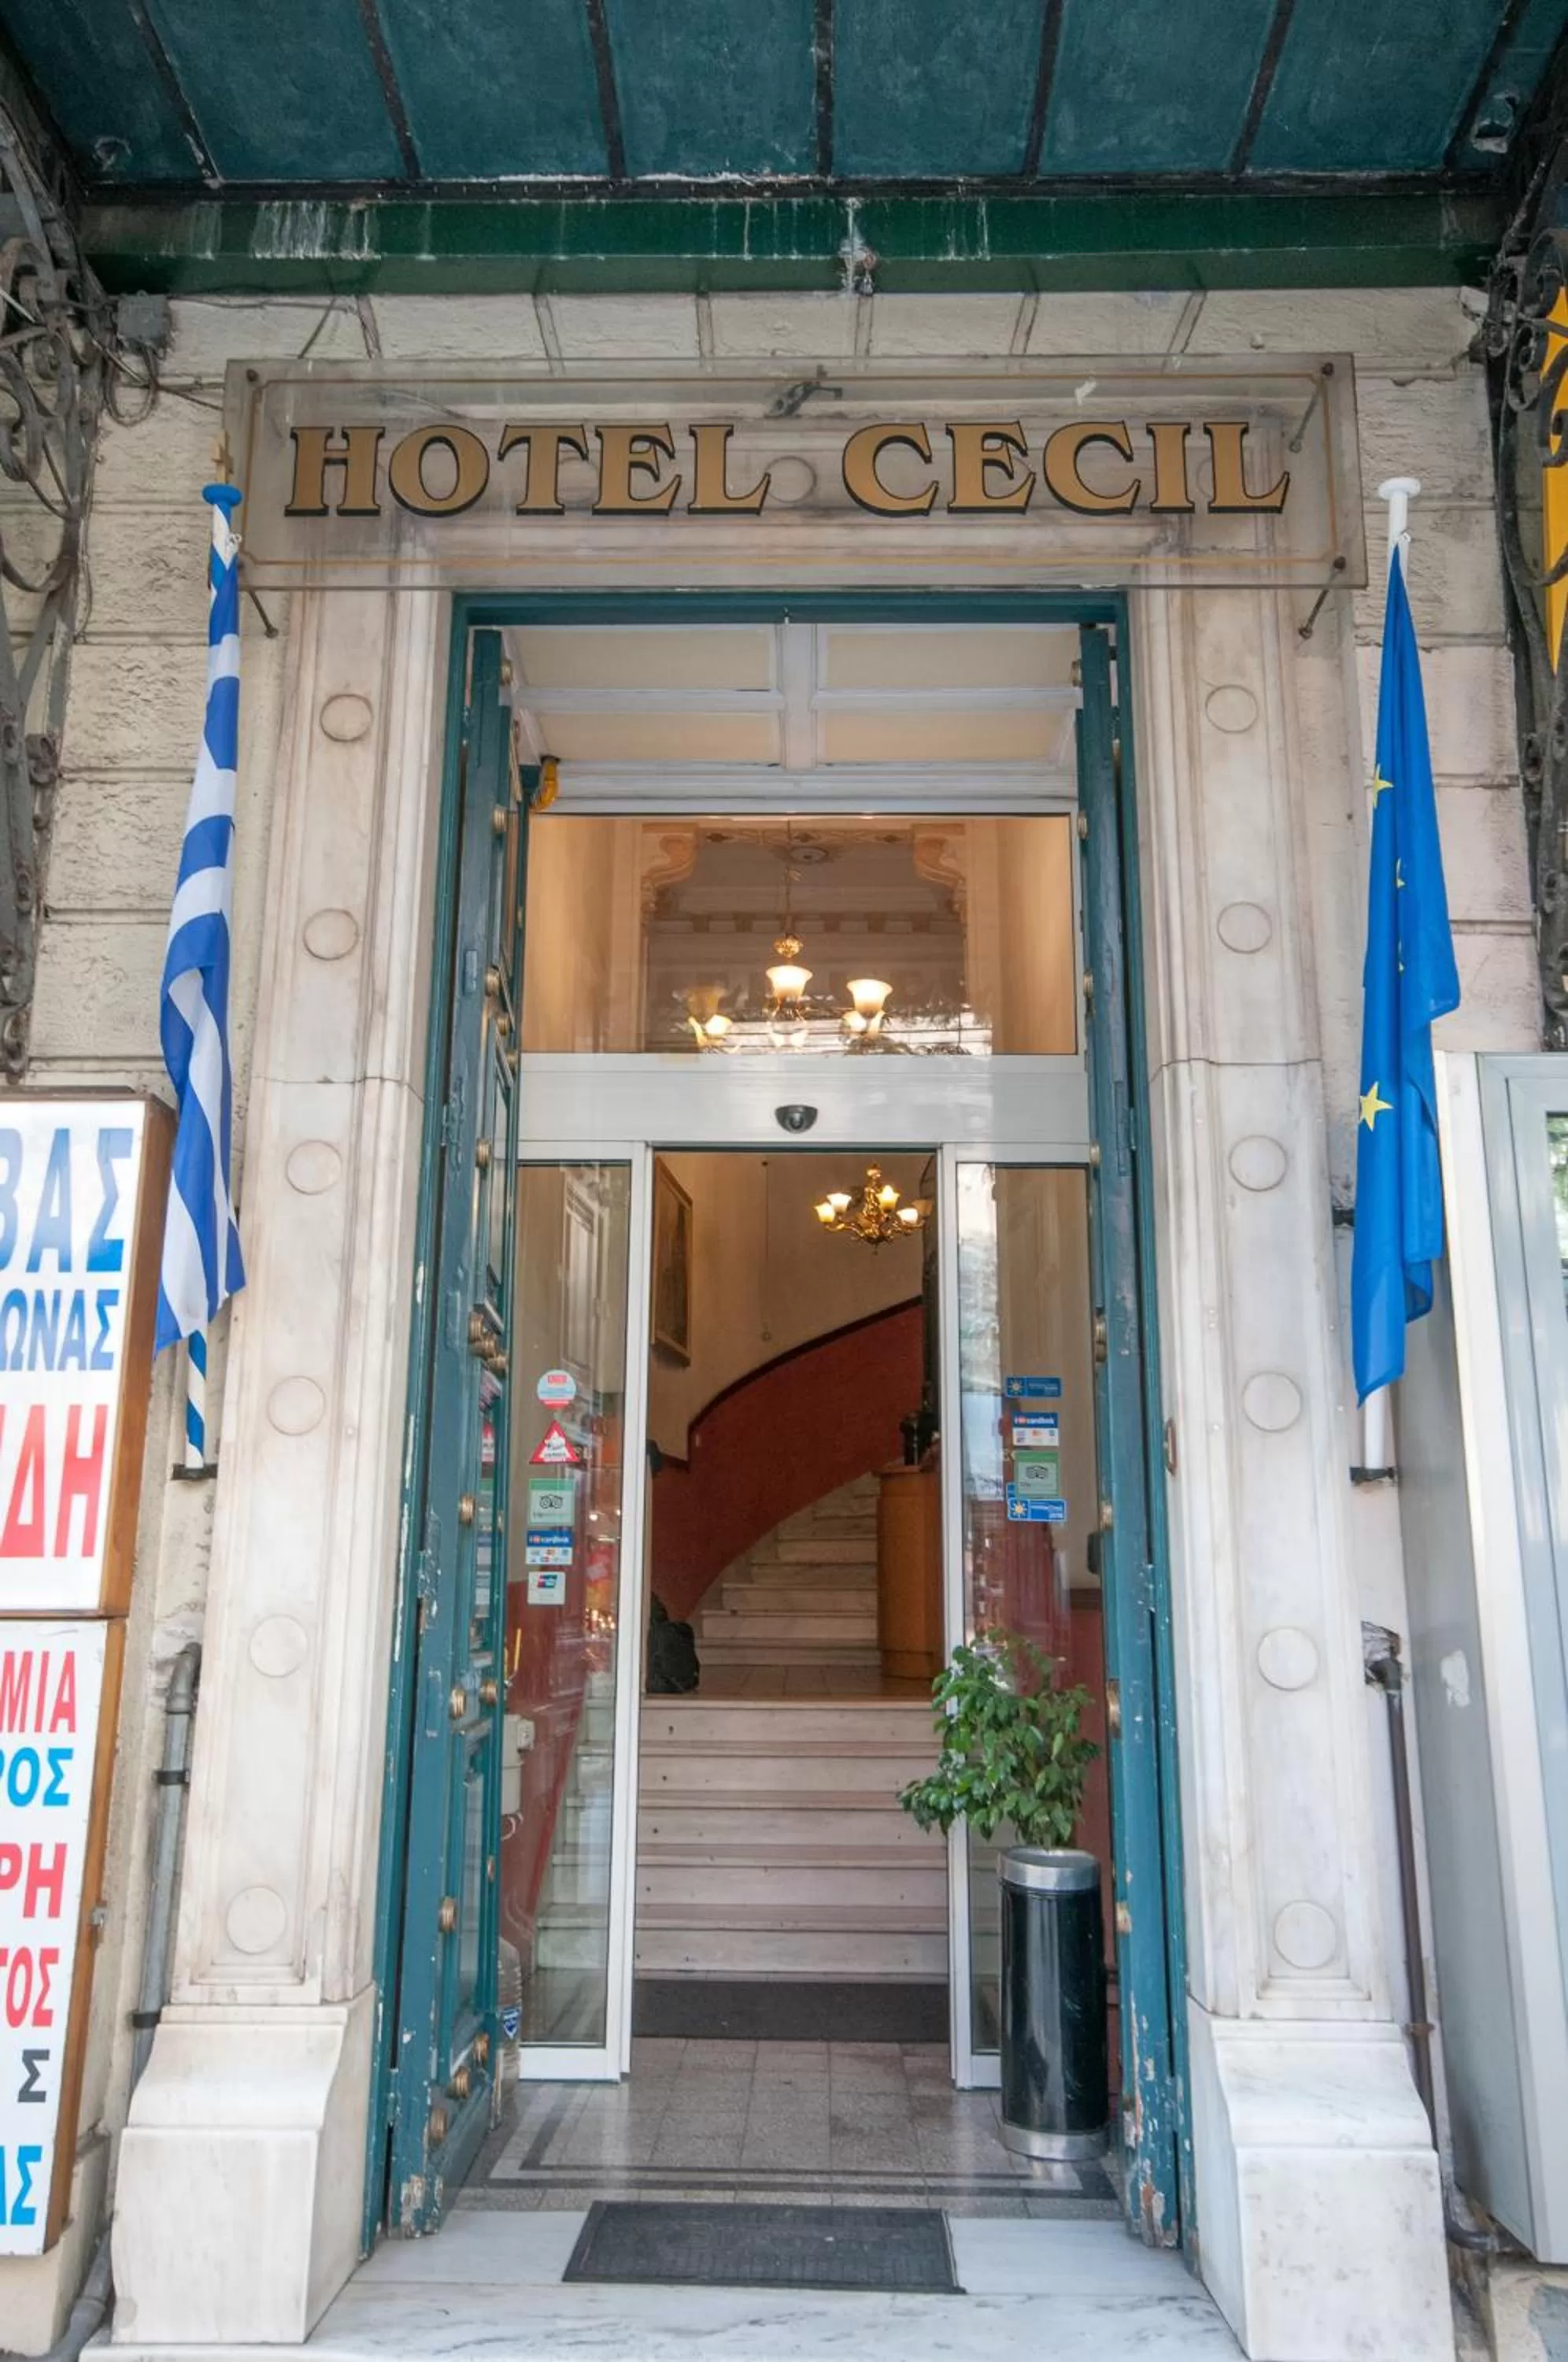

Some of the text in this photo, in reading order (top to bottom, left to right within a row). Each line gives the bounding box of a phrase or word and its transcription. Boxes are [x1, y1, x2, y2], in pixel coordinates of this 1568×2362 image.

[284, 420, 1290, 516] HOTEL CECIL
[0, 1288, 119, 1371] ΩΝΑΣ
[0, 1405, 108, 1557] ΔΗ
[0, 1650, 76, 1733] ΜΙΑ
[0, 1746, 74, 1807] ΟΣ
[0, 1946, 59, 2028] ΟΣ
